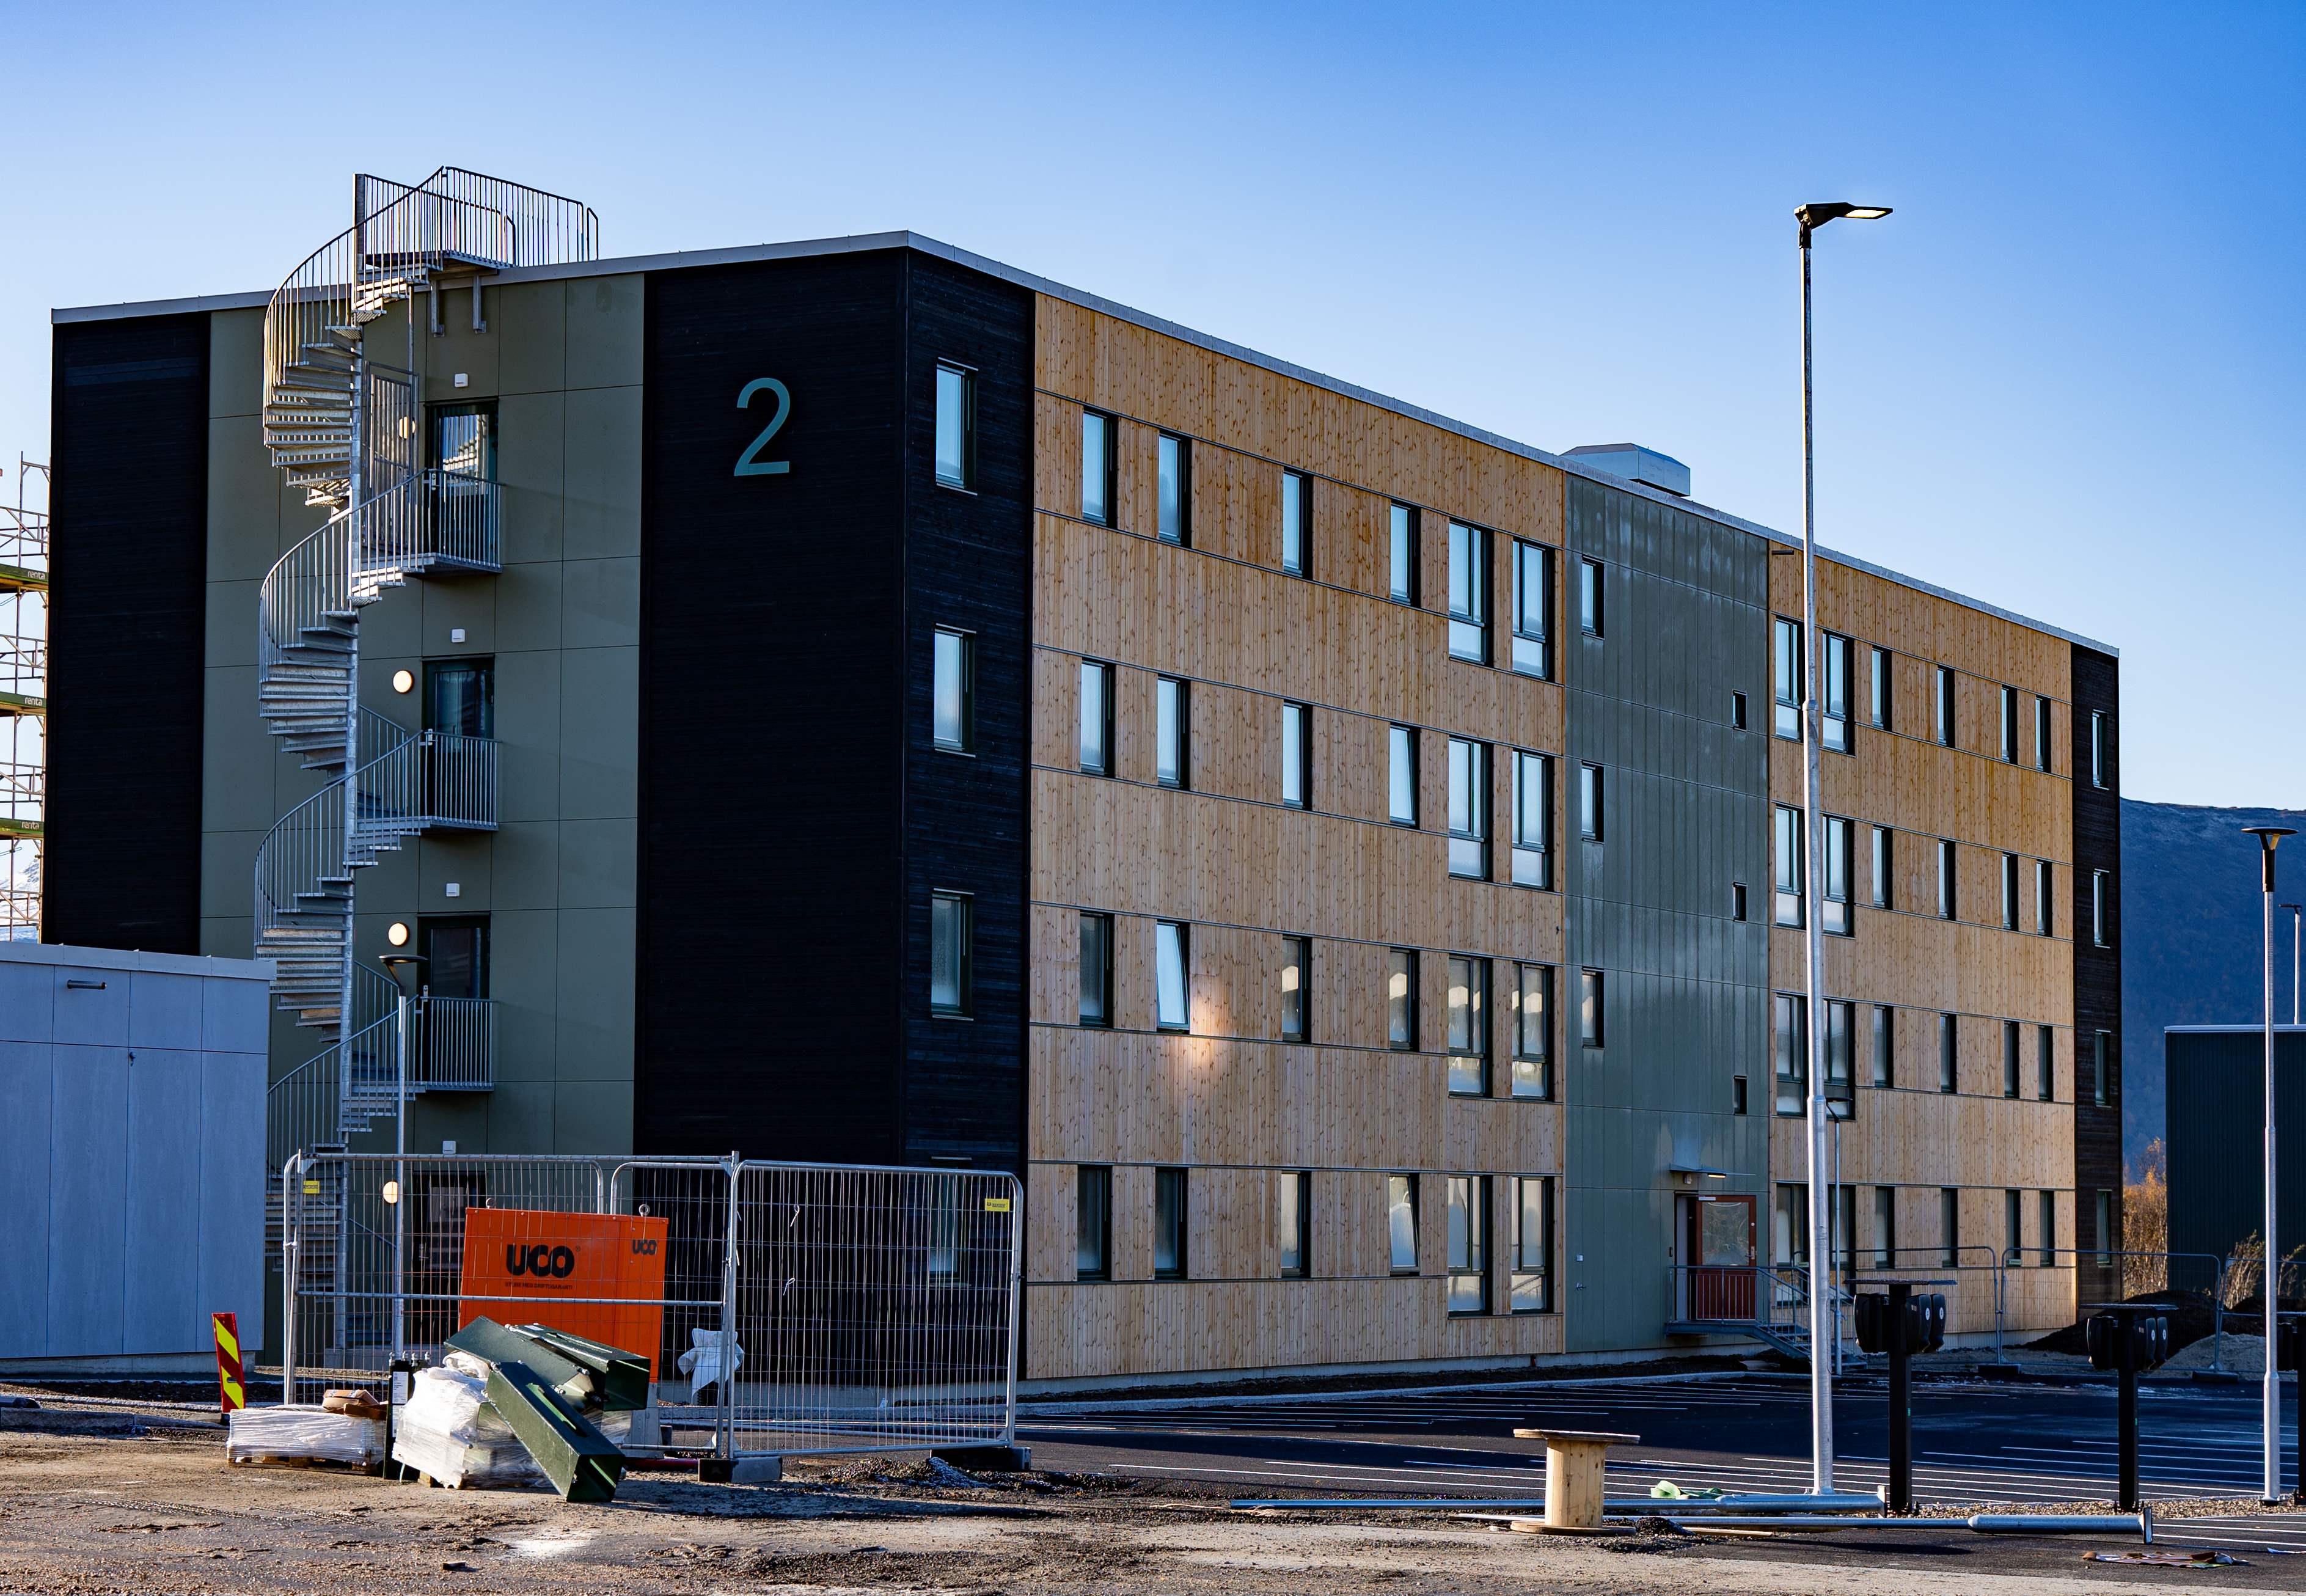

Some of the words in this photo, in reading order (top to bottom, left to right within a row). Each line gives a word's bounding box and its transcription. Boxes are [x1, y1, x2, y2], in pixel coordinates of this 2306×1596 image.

[734, 377, 791, 477] 2
[27, 571, 45, 580] renta
[25, 697, 43, 706] renta
[21, 821, 40, 830] renta
[632, 1239, 657, 1255] UCO
[506, 1244, 574, 1279] UCO
